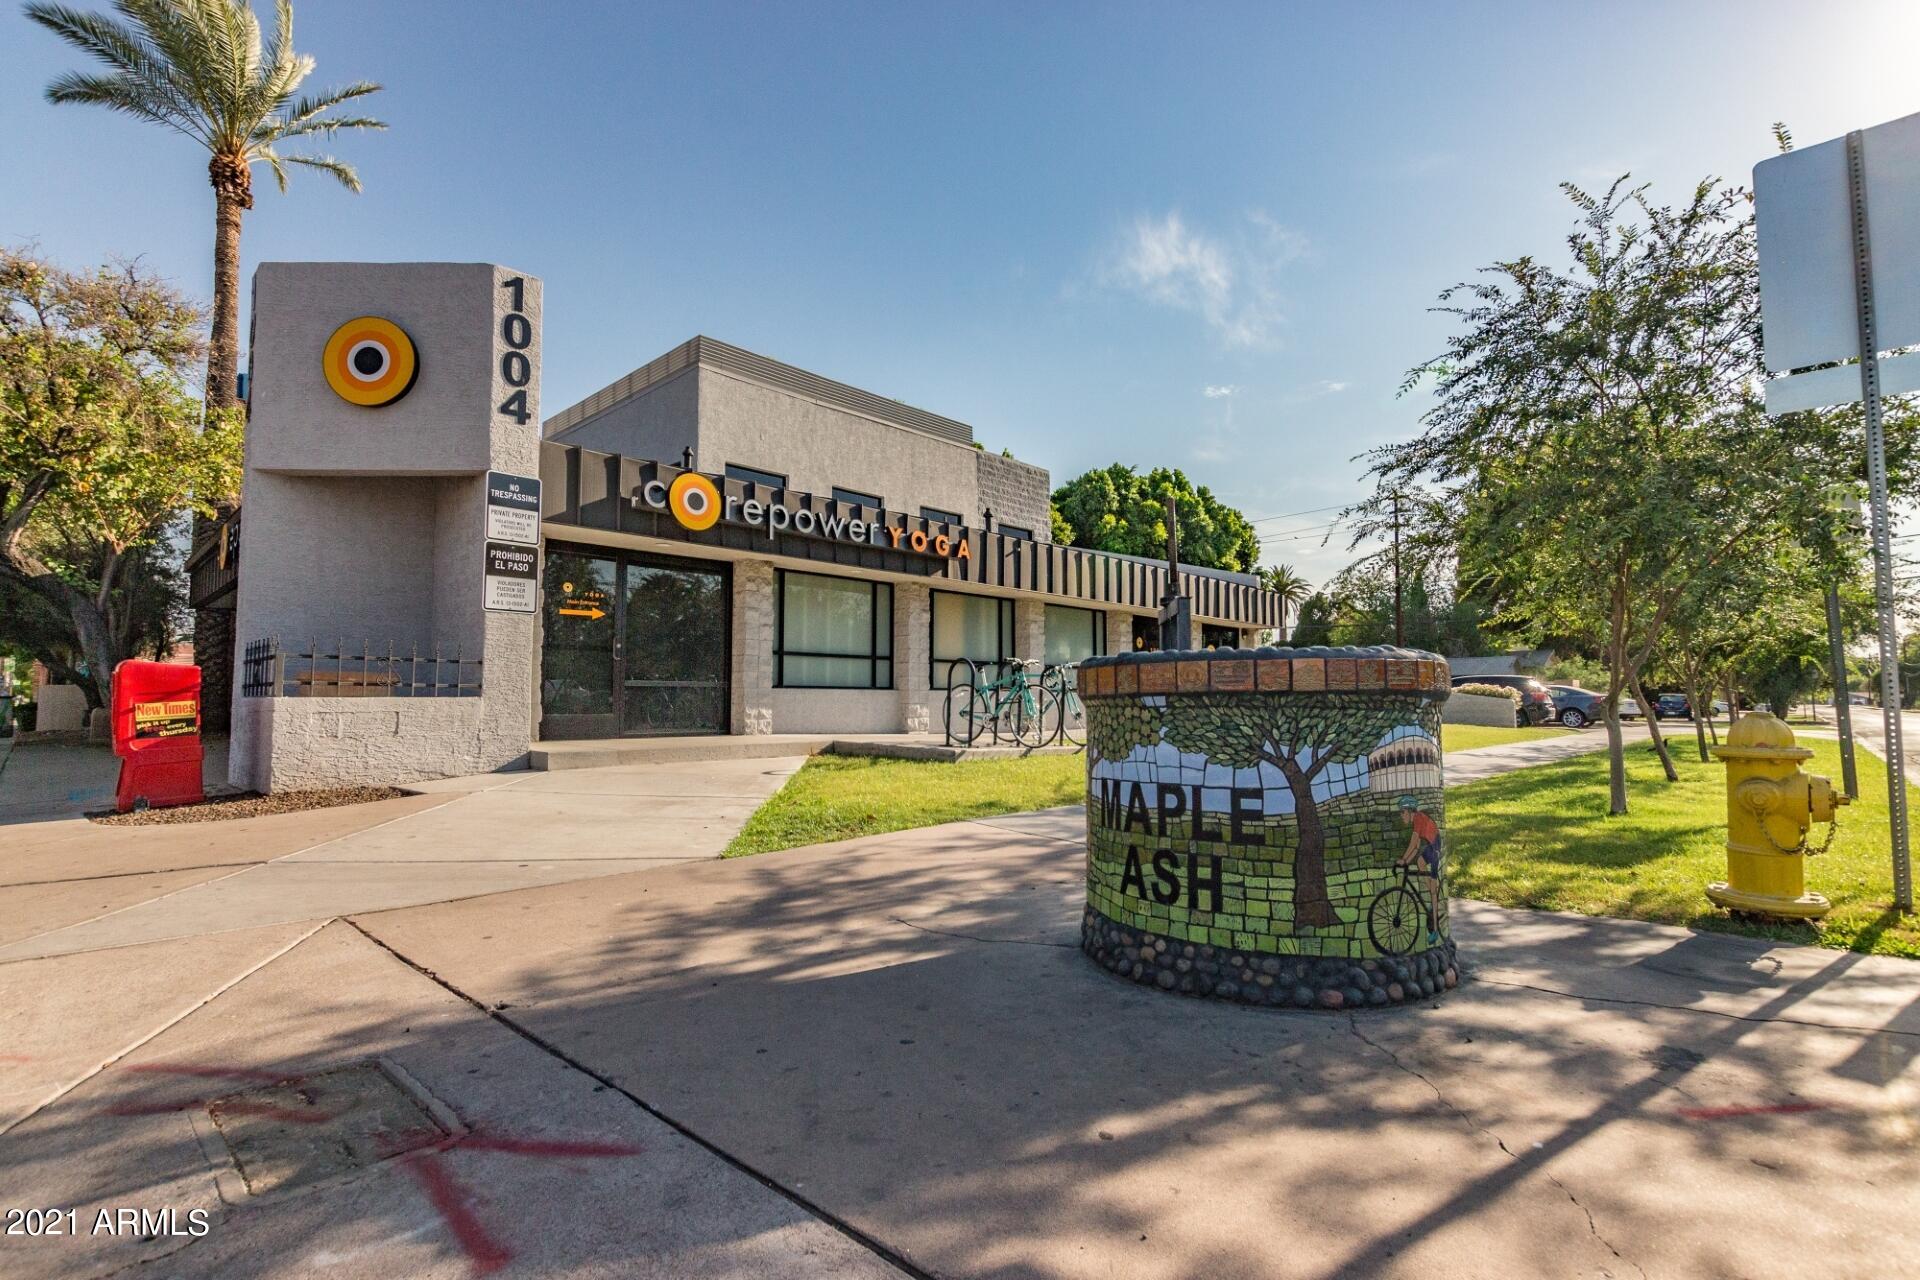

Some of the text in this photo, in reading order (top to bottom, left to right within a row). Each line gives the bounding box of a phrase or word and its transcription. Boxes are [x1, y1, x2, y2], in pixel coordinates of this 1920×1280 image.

[499, 276, 532, 426] 1004
[509, 484, 520, 492] NO
[490, 489, 538, 503] TRESPASSING
[490, 509, 536, 521] PRIVATE PROPERTY
[886, 525, 972, 560] YOGA
[490, 549, 534, 563] PROHIBIDO
[495, 560, 529, 572] EL PASO
[137, 702, 196, 716] New Times
[136, 722, 152, 730] pick
[159, 726, 198, 737] thursday
[166, 721, 187, 730] every
[1101, 777, 1266, 845] MAPLE
[1120, 844, 1223, 913] ASH
